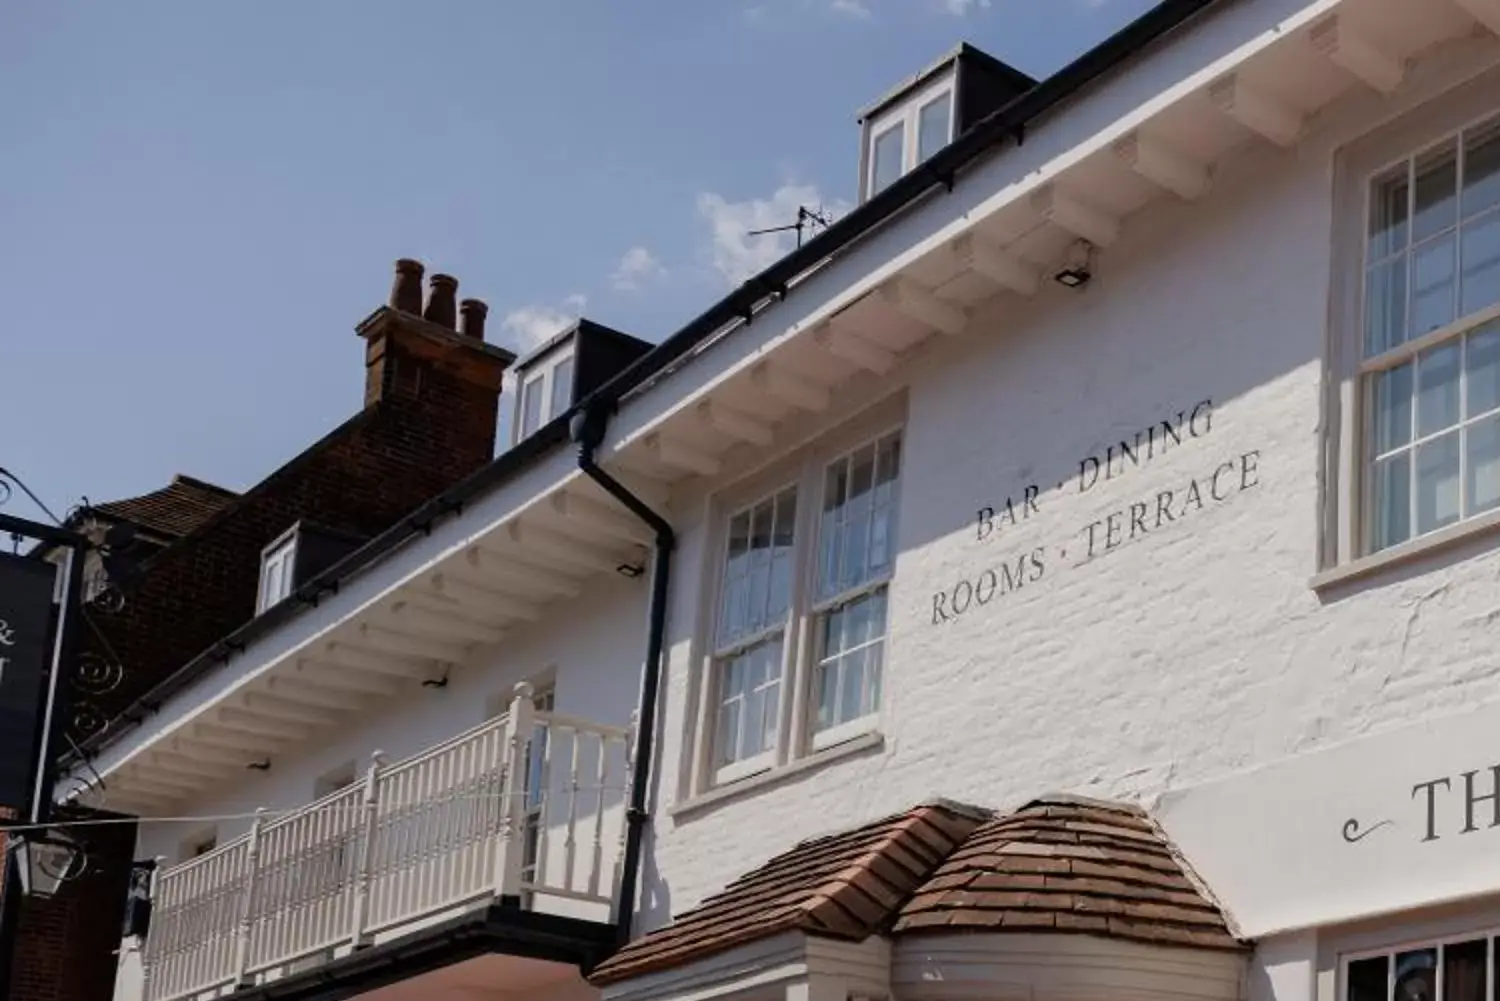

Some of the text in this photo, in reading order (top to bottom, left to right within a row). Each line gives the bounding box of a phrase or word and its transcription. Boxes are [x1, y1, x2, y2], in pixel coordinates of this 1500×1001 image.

[931, 450, 1261, 626] ROOMS TERRACE
[976, 399, 1213, 541] BAR DINING
